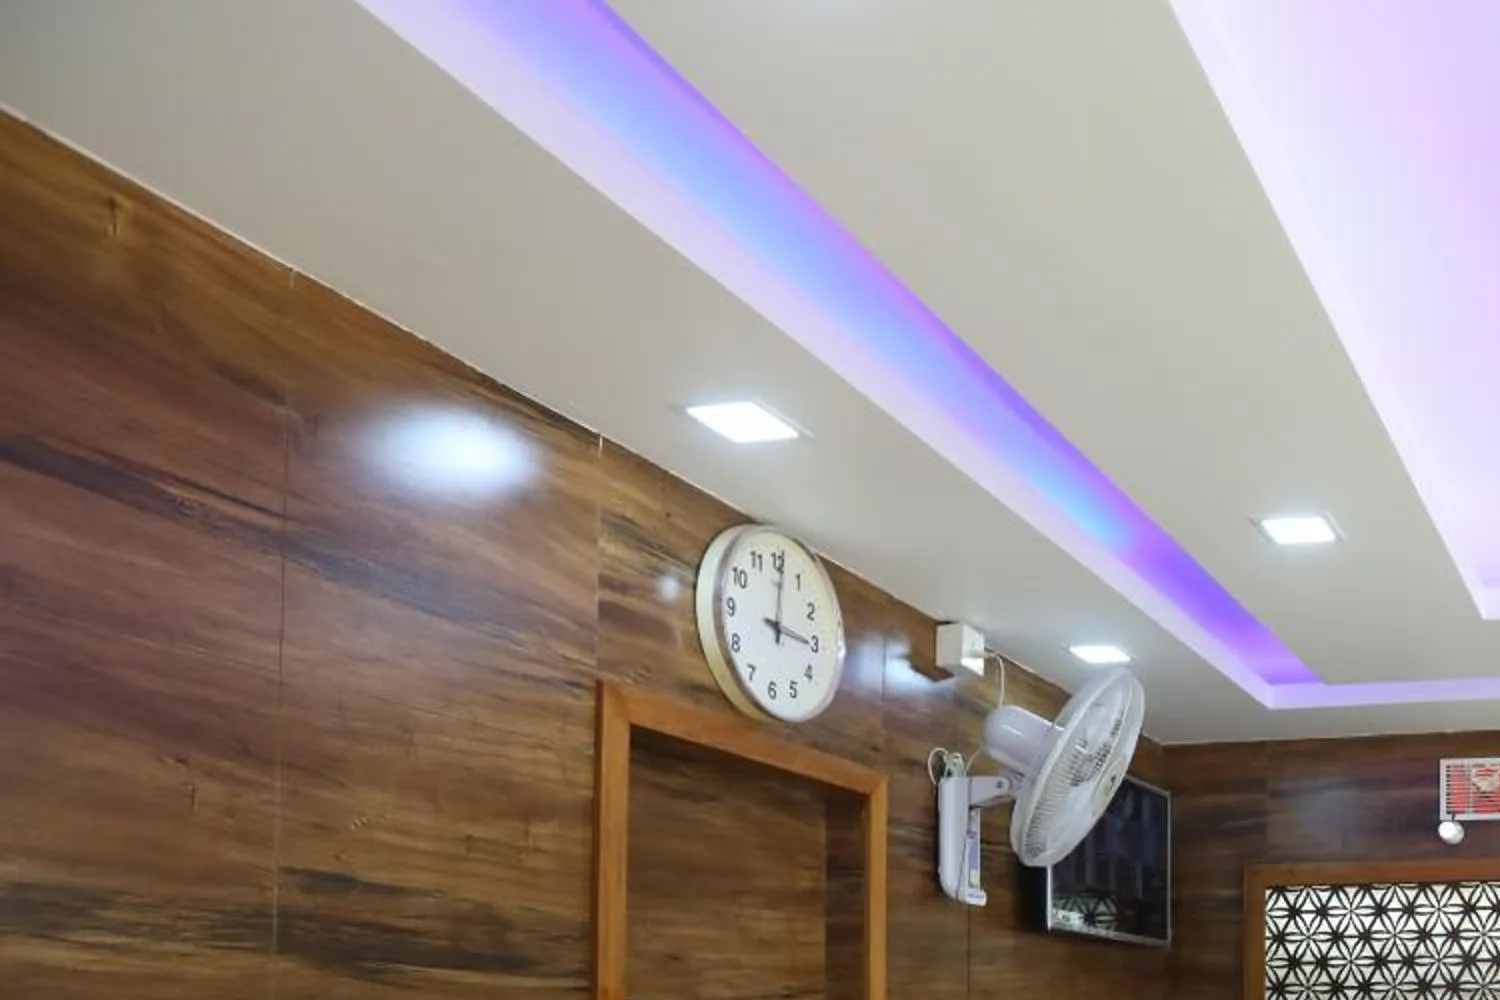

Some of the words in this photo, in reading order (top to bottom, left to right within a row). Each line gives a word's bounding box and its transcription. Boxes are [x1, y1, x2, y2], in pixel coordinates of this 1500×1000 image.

[750, 550, 763, 572] 11
[732, 566, 748, 589] 10
[795, 573, 802, 591] 1
[726, 597, 736, 617] 9
[806, 602, 815, 621] 2
[731, 633, 741, 653] 8
[811, 635, 819, 653] 3
[747, 663, 756, 681] 7
[804, 663, 813, 680] 4
[767, 681, 777, 700] 6
[789, 680, 798, 699] 5
